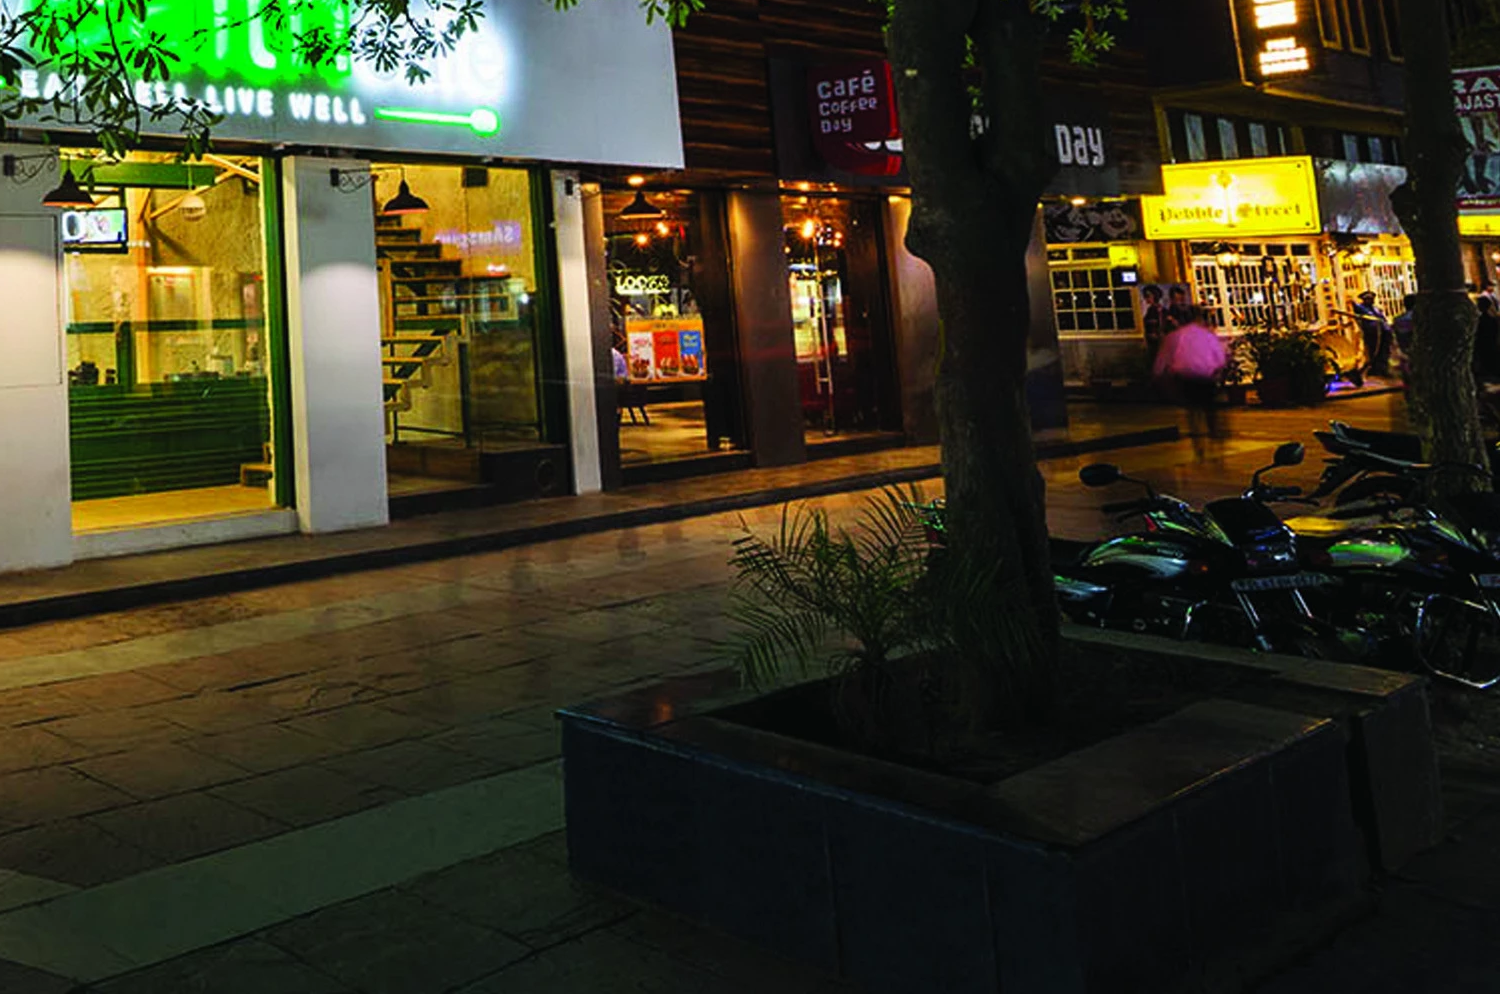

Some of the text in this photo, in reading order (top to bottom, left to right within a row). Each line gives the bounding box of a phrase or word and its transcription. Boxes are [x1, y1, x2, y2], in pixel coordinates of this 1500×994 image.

[204, 85, 274, 116] LIVE
[288, 92, 367, 124] WELL
[819, 97, 877, 116] Coffee
[820, 118, 852, 133] Day
[1054, 123, 1105, 166] Day
